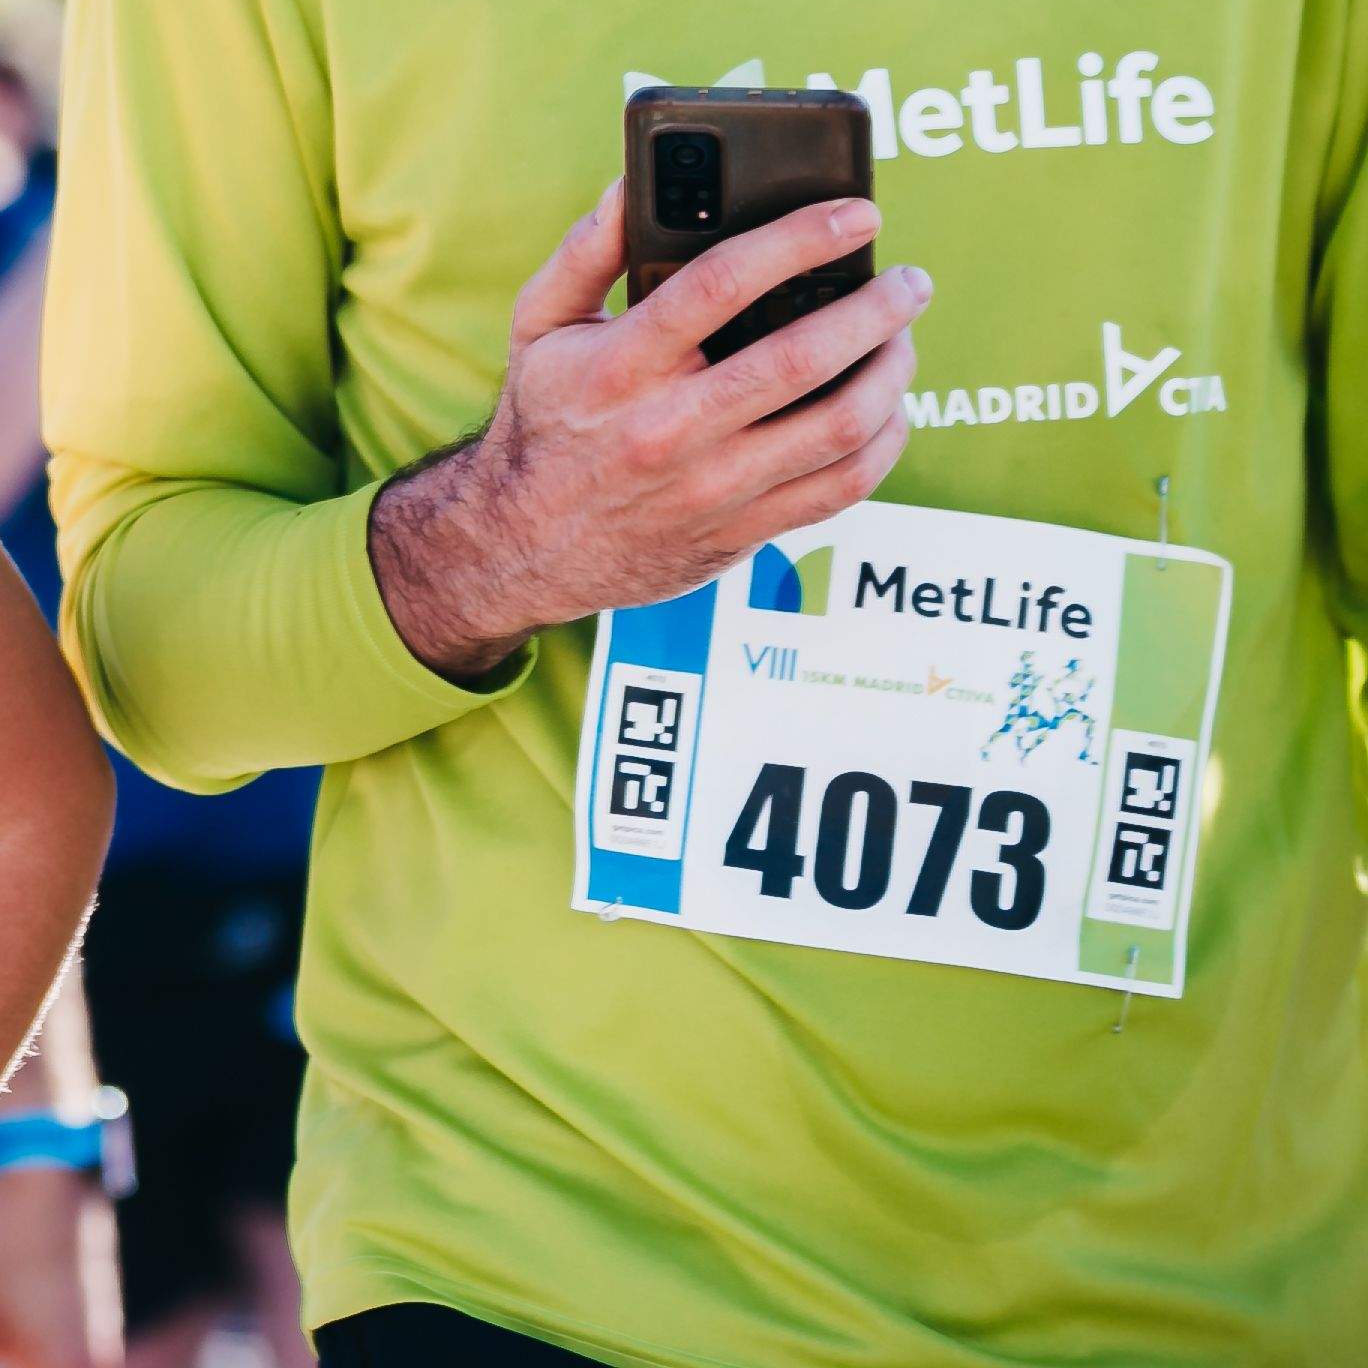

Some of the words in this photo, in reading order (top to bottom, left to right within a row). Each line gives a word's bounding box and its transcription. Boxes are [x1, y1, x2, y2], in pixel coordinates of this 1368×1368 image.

[903, 382, 1098, 428] MADRID
[854, 561, 1094, 639] MetLife
[743, 642, 798, 681] VIII
[853, 675, 924, 695] MADRID
[723, 762, 1051, 931] 4073
